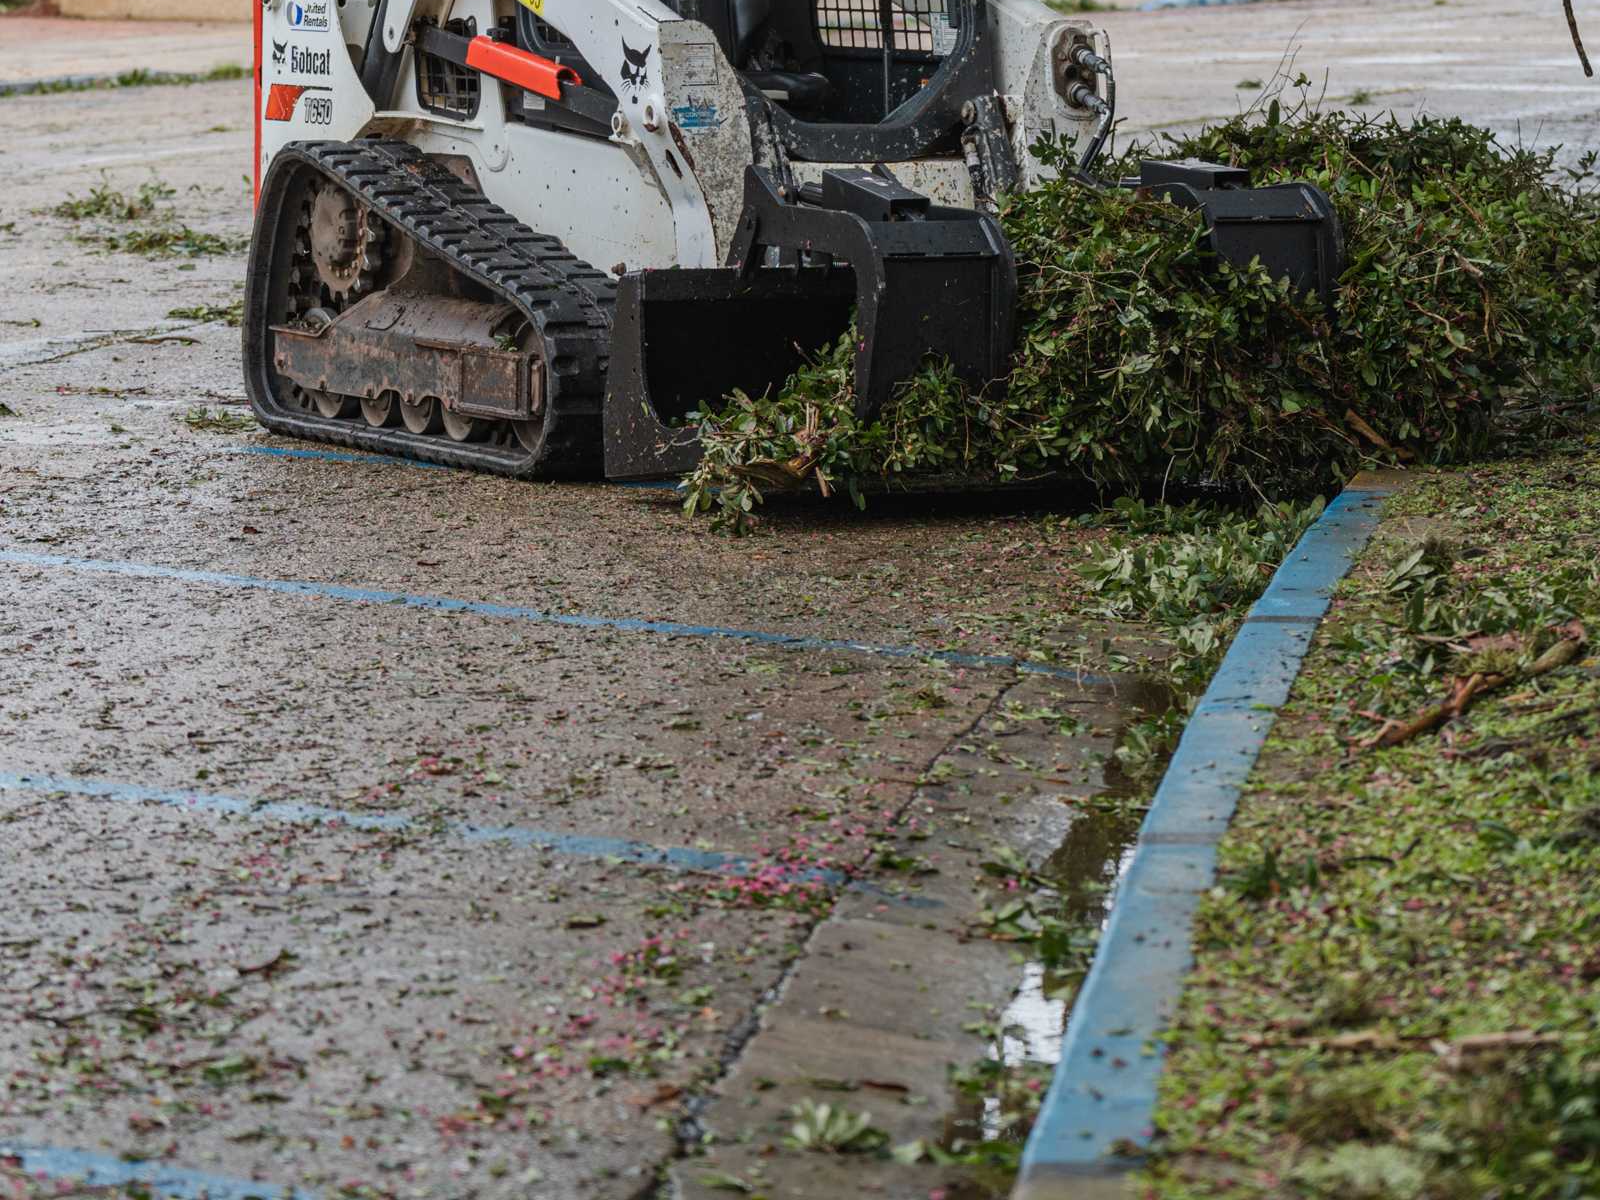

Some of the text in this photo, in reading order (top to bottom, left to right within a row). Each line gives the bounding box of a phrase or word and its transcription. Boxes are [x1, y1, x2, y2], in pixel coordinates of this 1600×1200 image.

[304, 14, 328, 27] Rentals
[291, 45, 331, 75] Bobcat
[304, 97, 333, 125] T650
